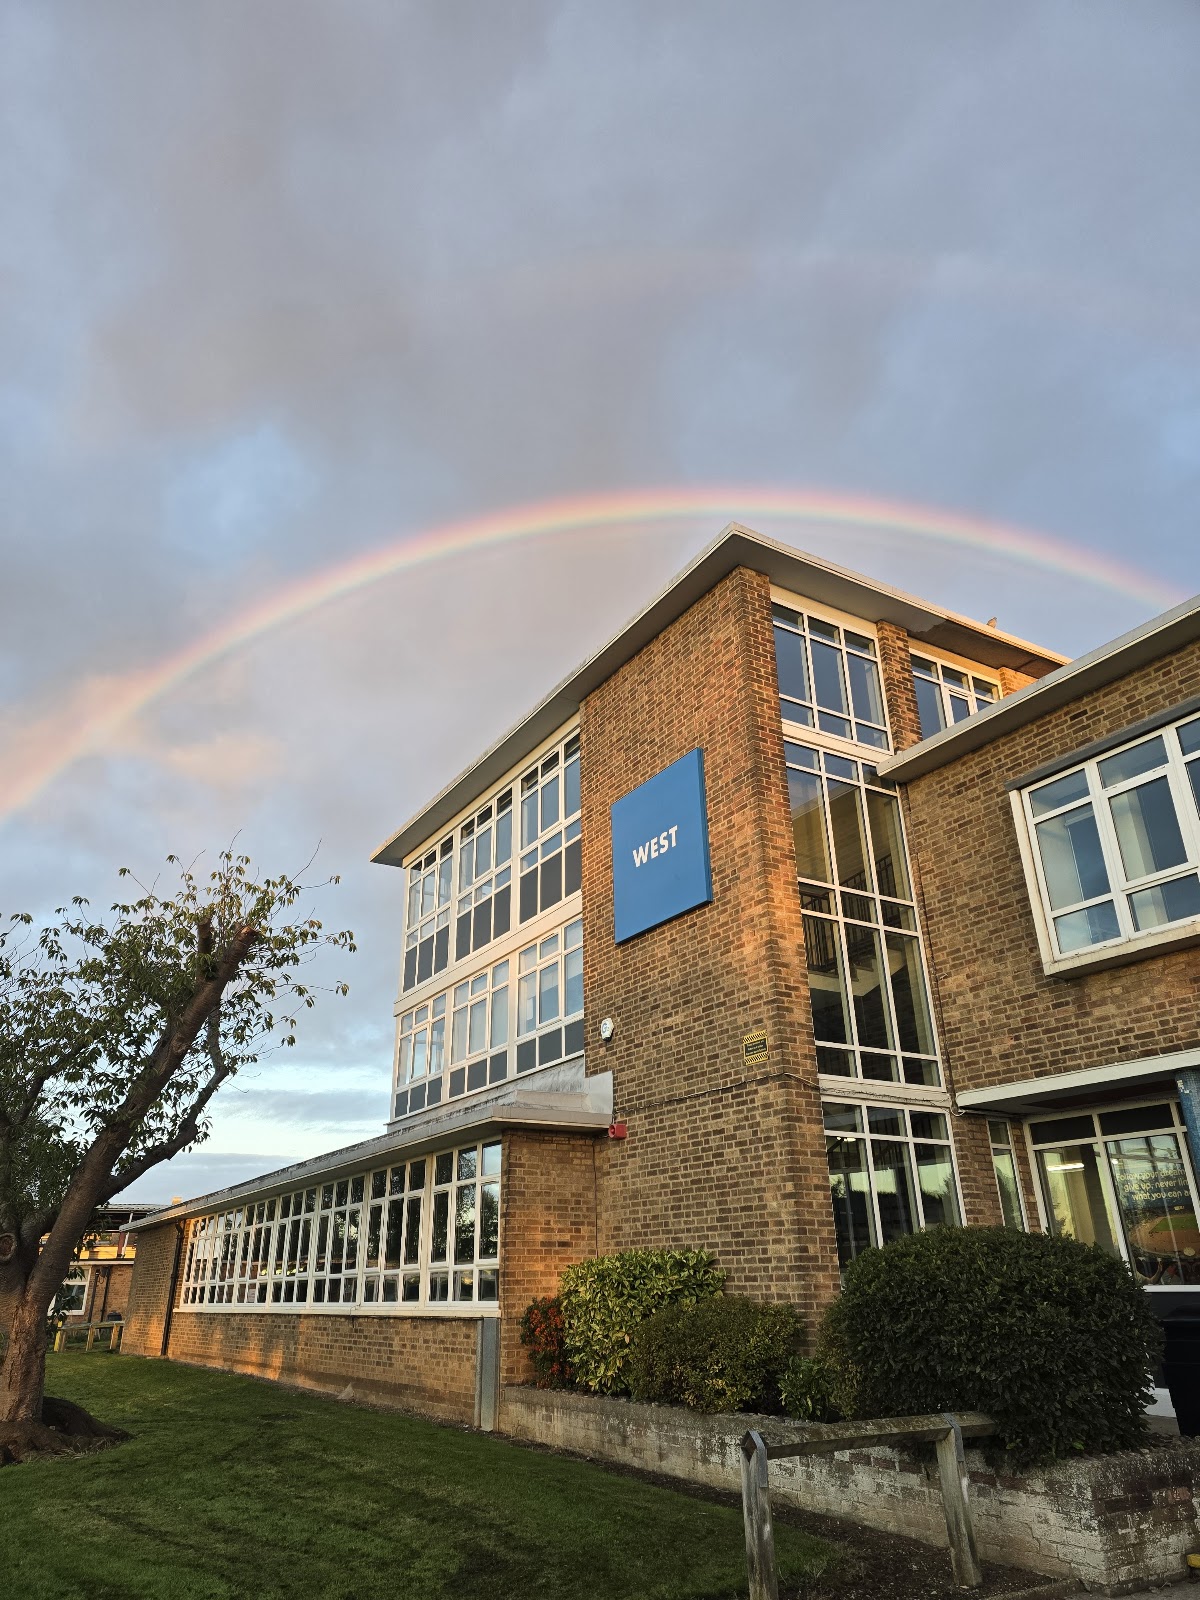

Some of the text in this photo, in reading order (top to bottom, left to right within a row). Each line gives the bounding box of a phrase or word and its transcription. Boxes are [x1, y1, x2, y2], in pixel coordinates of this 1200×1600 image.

[633, 825, 678, 868] WEST
[1139, 1171, 1159, 1180] your
[1124, 1182, 1140, 1192] give
[1155, 1180, 1177, 1188] never
[1132, 1191, 1150, 1200] what
[1151, 1192, 1166, 1200] you
[1168, 1190, 1182, 1198] can
